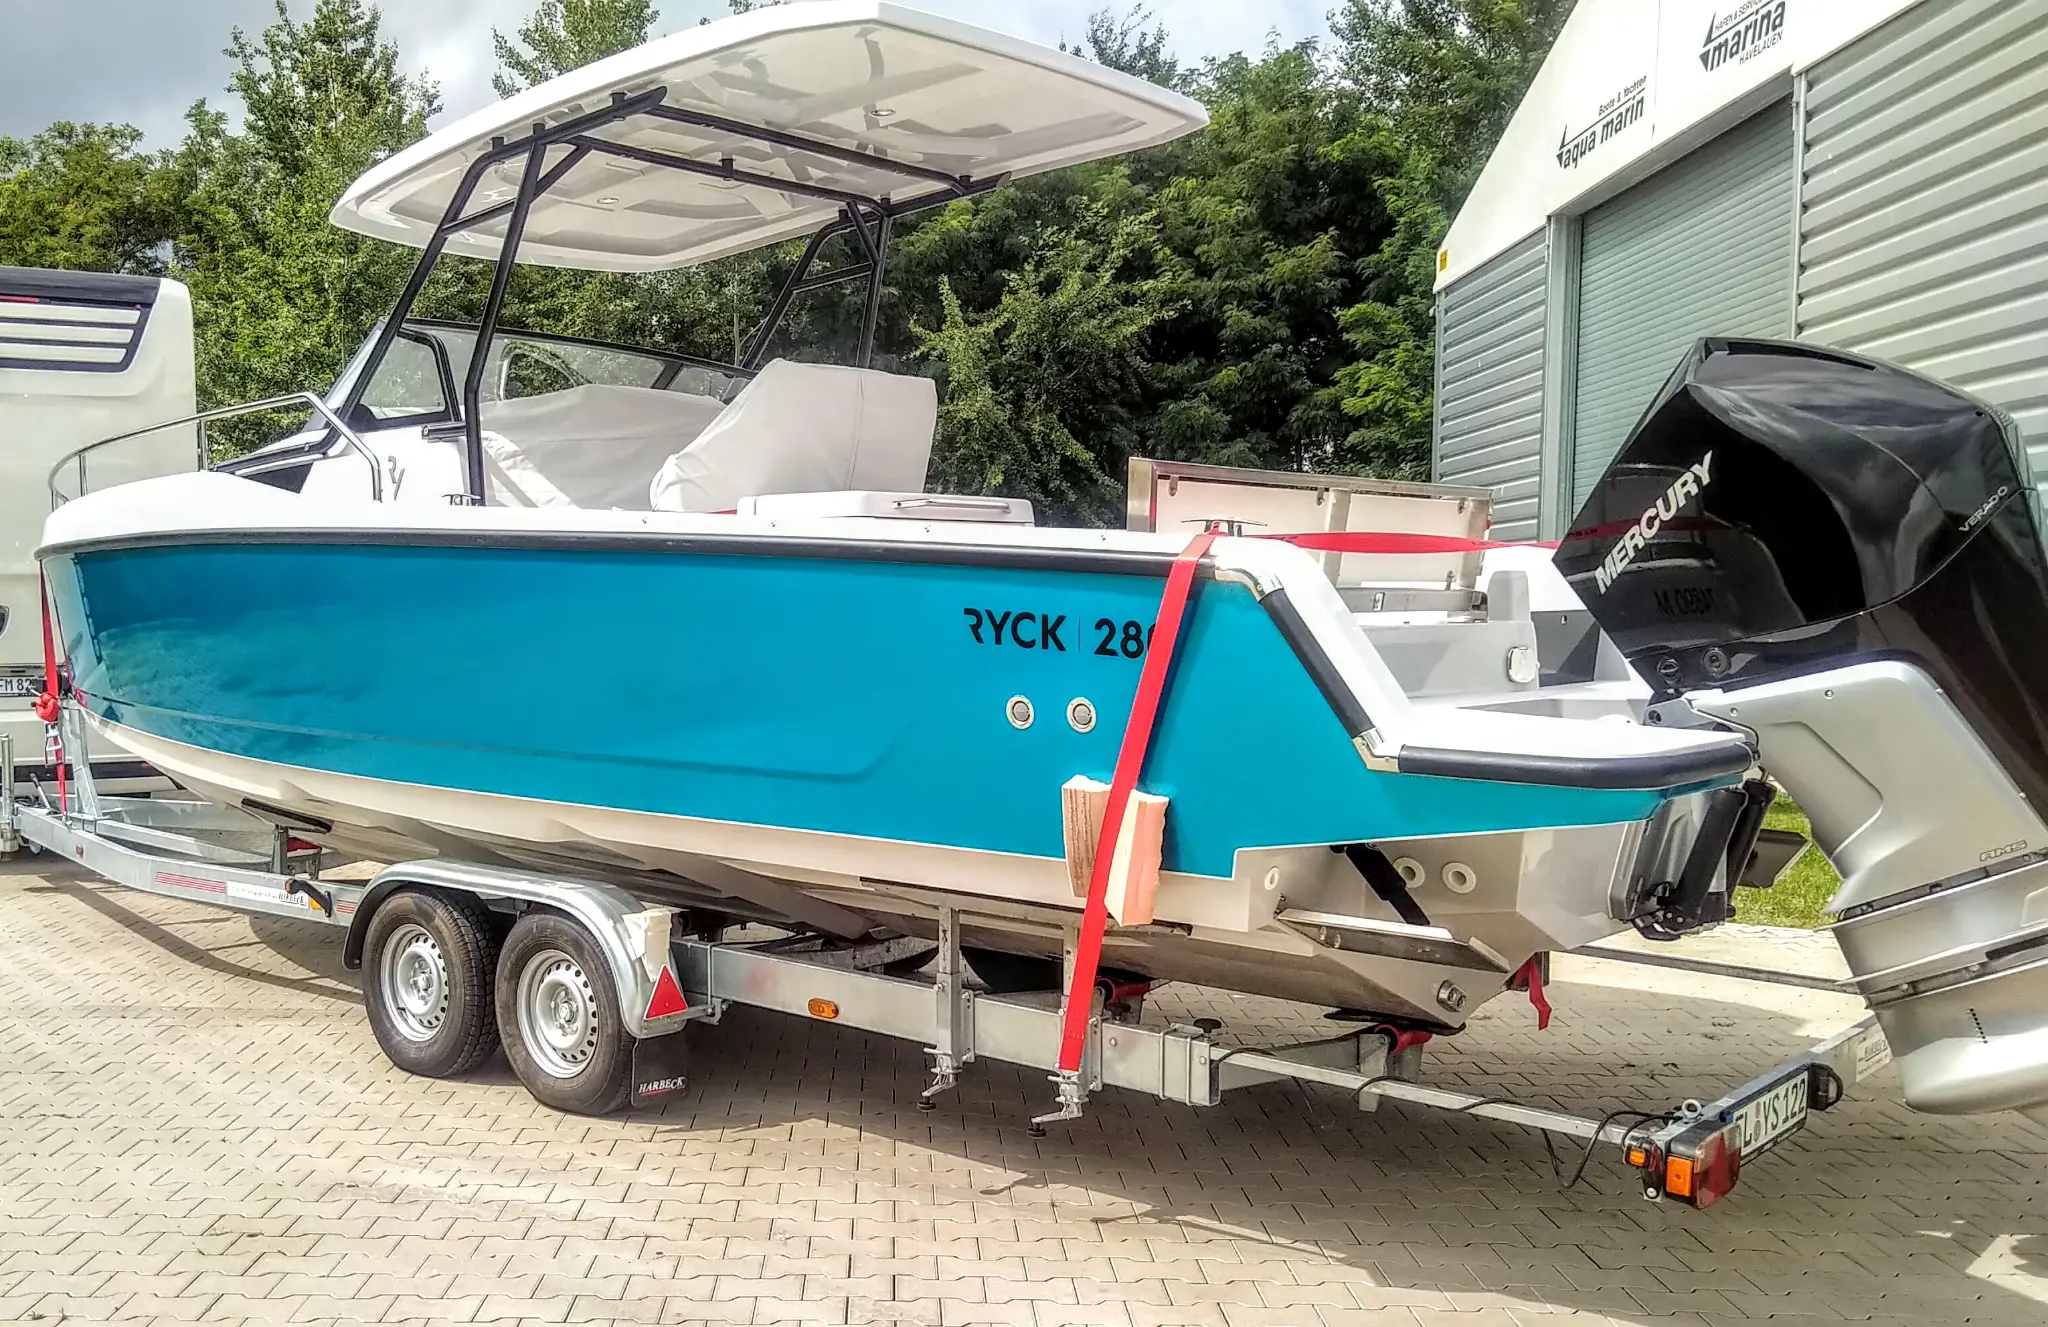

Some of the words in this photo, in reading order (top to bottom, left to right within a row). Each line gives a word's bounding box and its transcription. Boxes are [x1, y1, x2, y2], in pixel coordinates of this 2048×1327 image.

[1710, 1, 1786, 72] marina
[1739, 30, 1783, 65] HAVELAUEN
[1564, 130, 1597, 170] aqua
[1600, 95, 1645, 145] marin
[1595, 450, 1713, 595] MERCURY
[1958, 486, 2008, 532] VERADO
[963, 607, 1067, 652] RYCK
[1979, 839, 2028, 862] AMS
[638, 1076, 686, 1094] HARBECK
[1735, 1111, 1753, 1149] L
[1763, 1092, 1780, 1136] YS
[1781, 1077, 1806, 1125] 122
